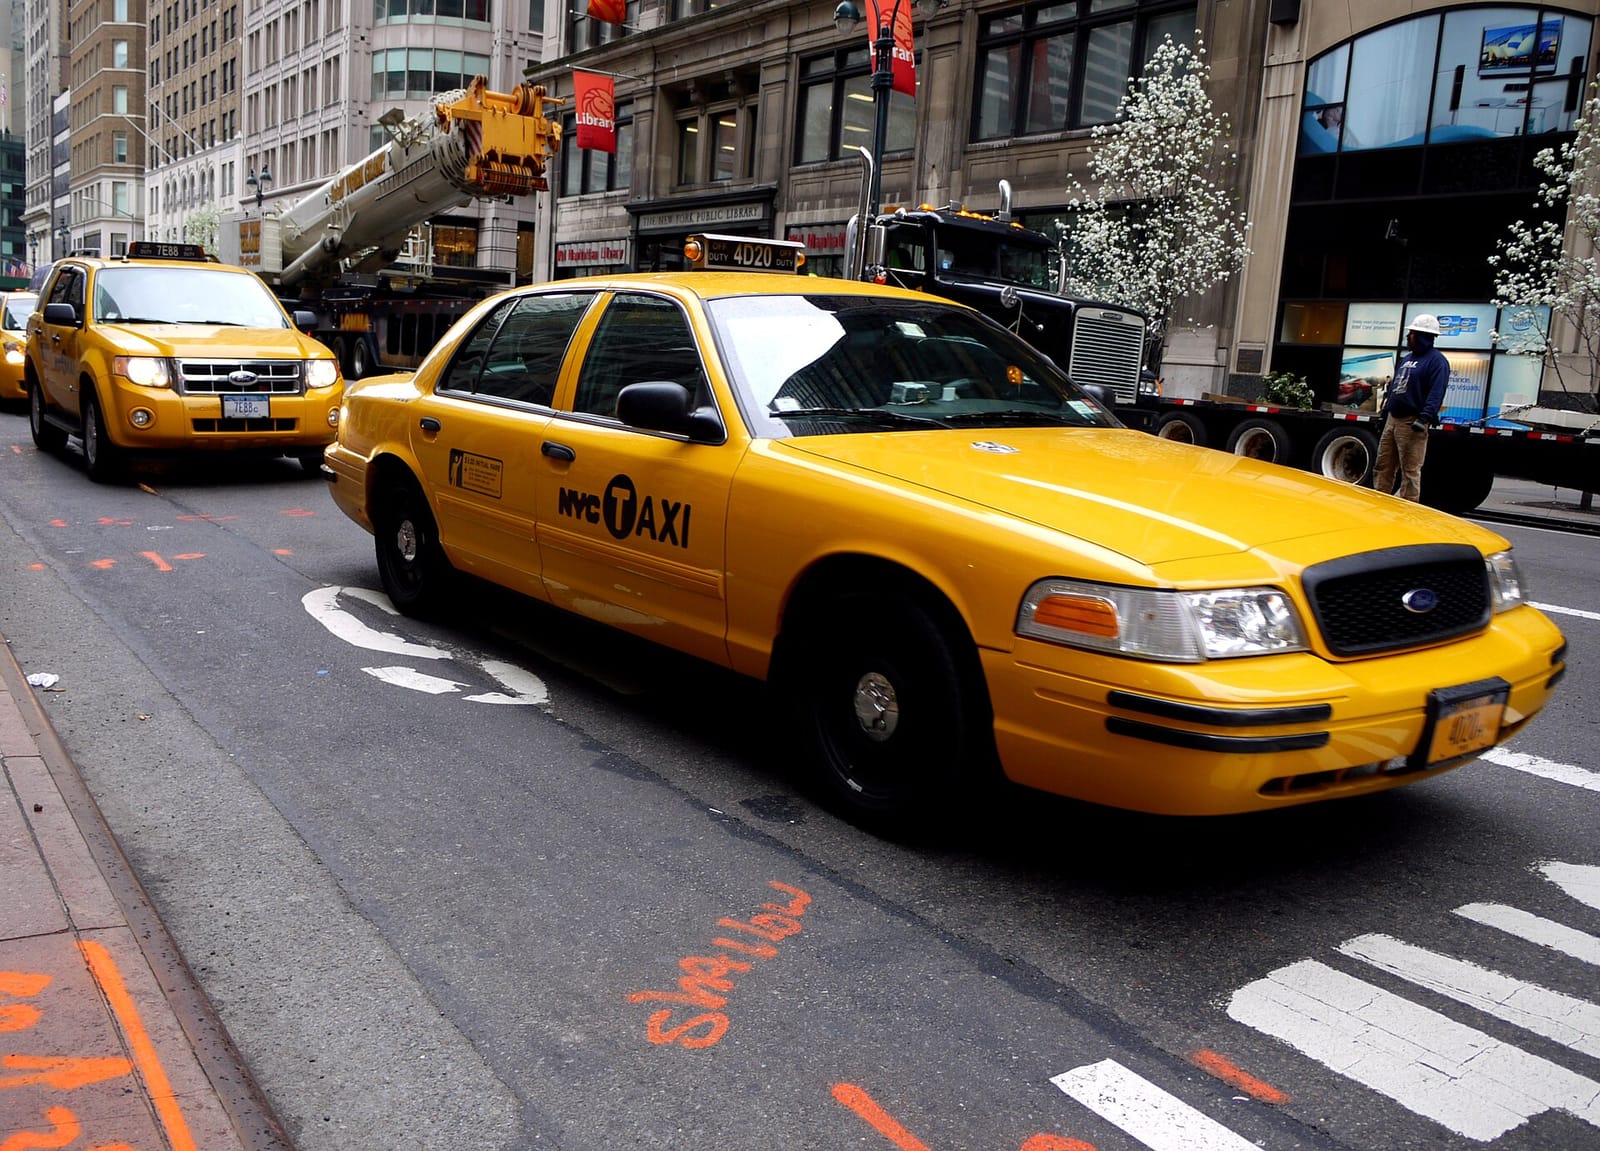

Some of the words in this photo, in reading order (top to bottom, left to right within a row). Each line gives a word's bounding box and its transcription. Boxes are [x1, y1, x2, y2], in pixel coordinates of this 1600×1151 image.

[868, 40, 915, 69] Lrary
[575, 112, 616, 133] Library
[643, 217, 656, 227] THE
[658, 215, 673, 226] NEW
[675, 213, 694, 225] YORK
[696, 211, 723, 222] PUBLIC
[726, 207, 759, 220] LIBRARY
[156, 245, 179, 257] 7E88
[709, 252, 729, 262] DUTY
[734, 242, 772, 268] 4D20
[775, 258, 794, 267] DUTY
[558, 486, 601, 525] NYC
